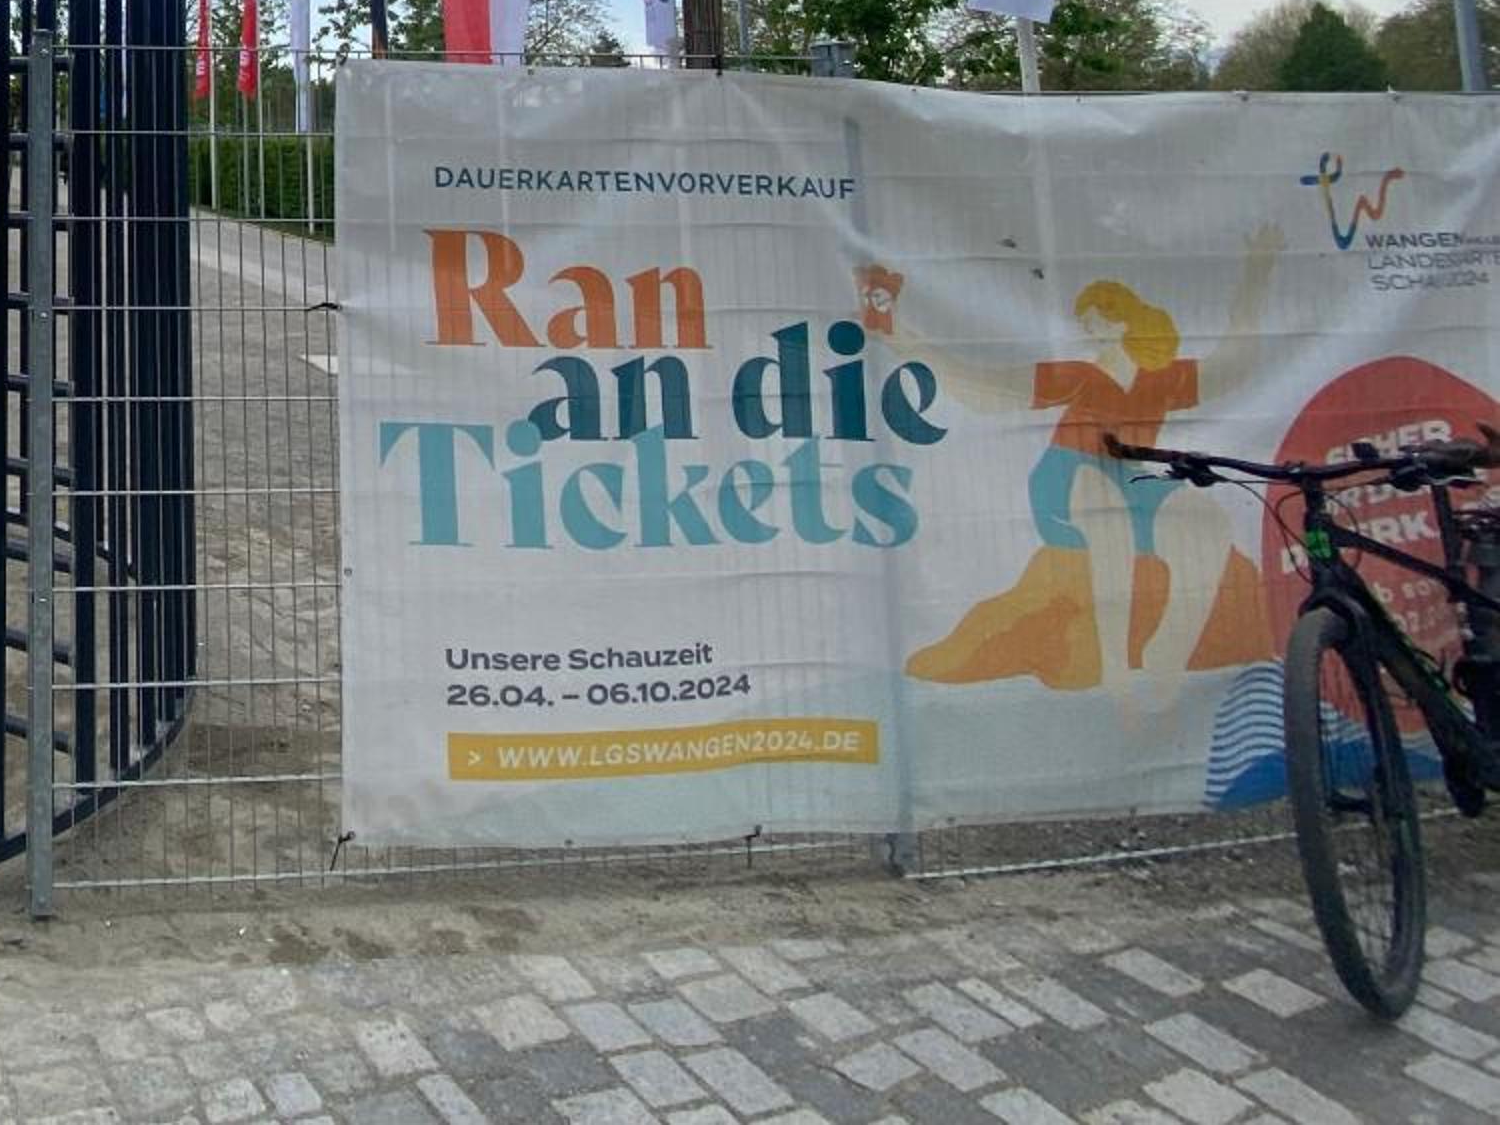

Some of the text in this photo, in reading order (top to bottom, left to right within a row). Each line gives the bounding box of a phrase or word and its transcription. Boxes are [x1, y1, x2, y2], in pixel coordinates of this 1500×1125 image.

[434, 166, 855, 201] DAUERKARTENVORVERKAUF
[424, 228, 713, 350] Ran
[527, 320, 948, 445] an die
[378, 418, 920, 550] Tickets
[445, 642, 713, 671] Unsere Schauzeit
[446, 683, 555, 708] 26.04.
[586, 674, 751, 706] 06.10.2024
[498, 730, 861, 769] WWW.LGSWANGEN2024.DE
